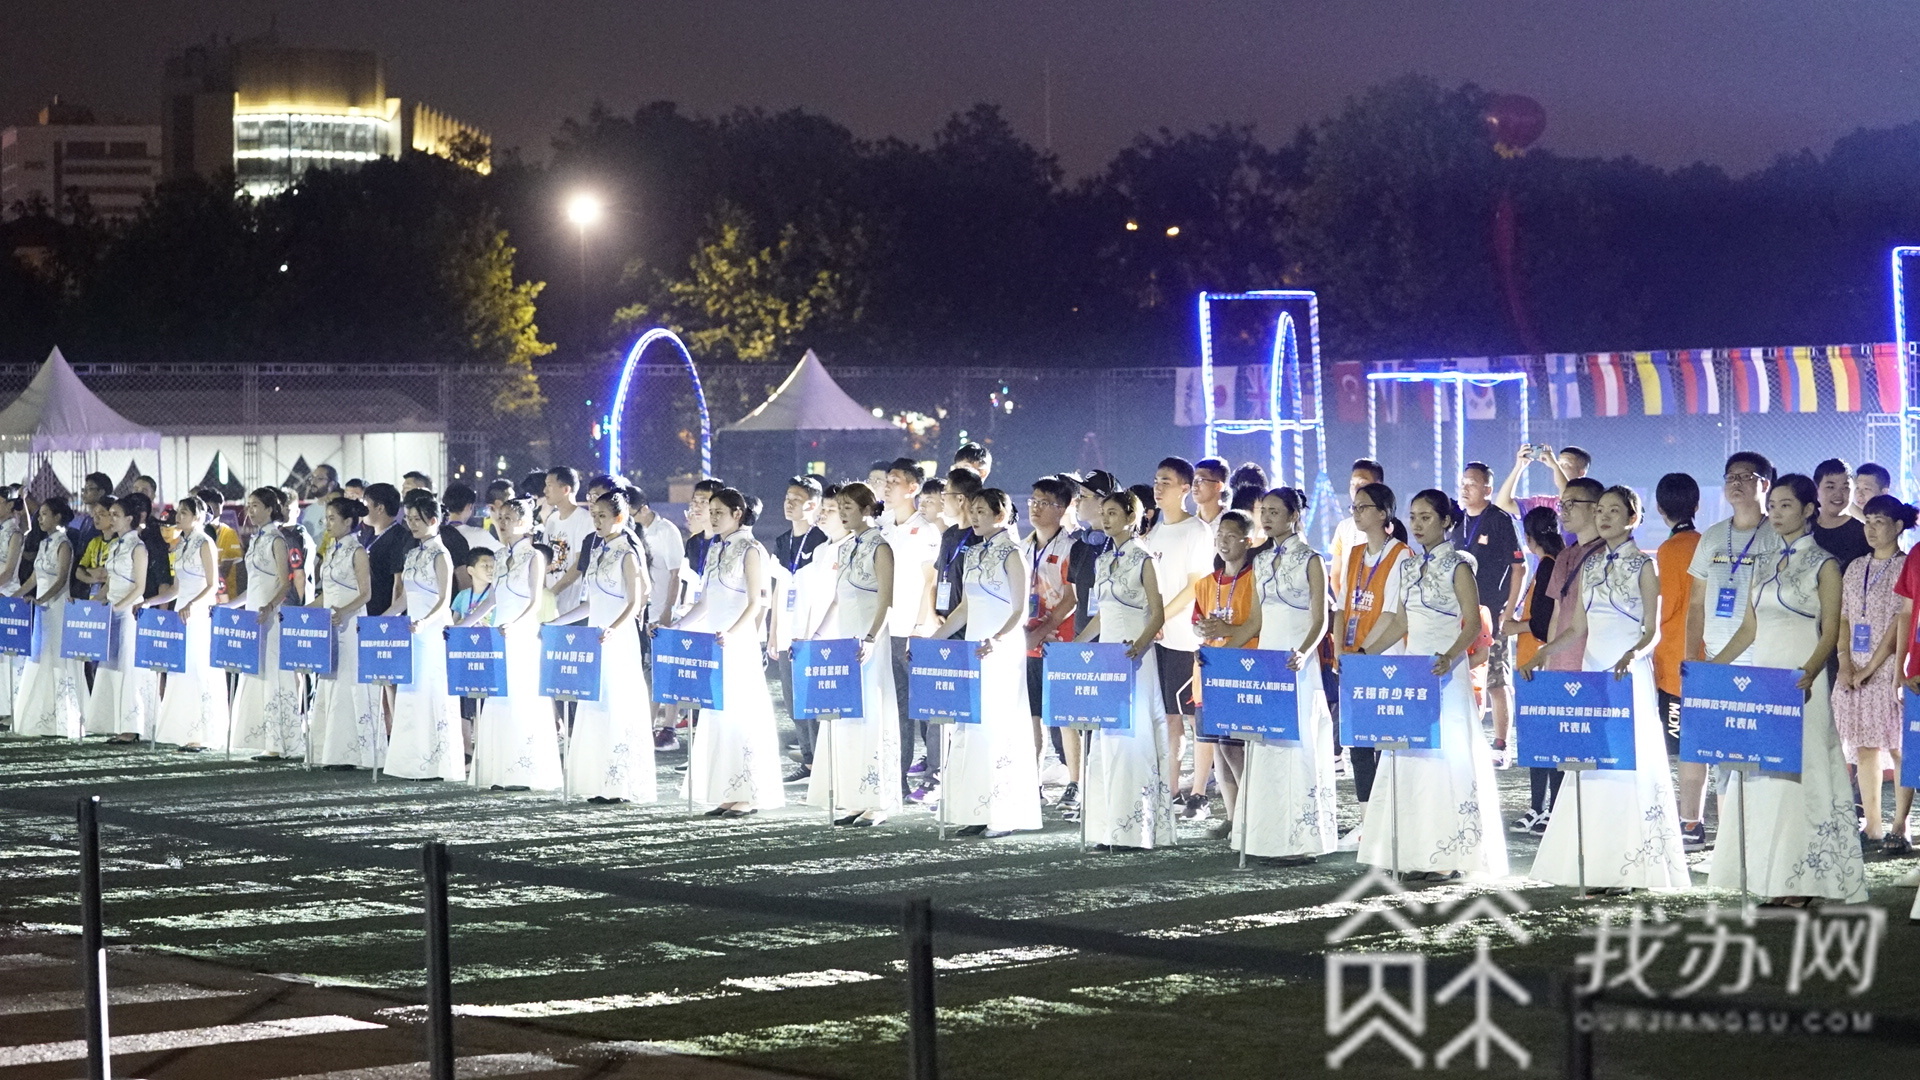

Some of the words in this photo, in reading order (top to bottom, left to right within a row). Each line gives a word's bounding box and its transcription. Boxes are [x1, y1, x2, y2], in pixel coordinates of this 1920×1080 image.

[546, 650, 594, 664] WMM俱乐部
[678, 668, 698, 680] 代表队
[818, 680, 838, 690] 代表队
[935, 681, 955, 691] 代表队
[1074, 685, 1099, 696] 代表队
[1236, 693, 1263, 705] 代表队
[1352, 686, 1428, 701] 无锡市少年宫
[1377, 704, 1404, 716] 代表队
[1519, 705, 1631, 719] 温州市海陆空模型运动协会
[1559, 721, 1591, 734] 代表队
[1725, 716, 1758, 731] 代表队
